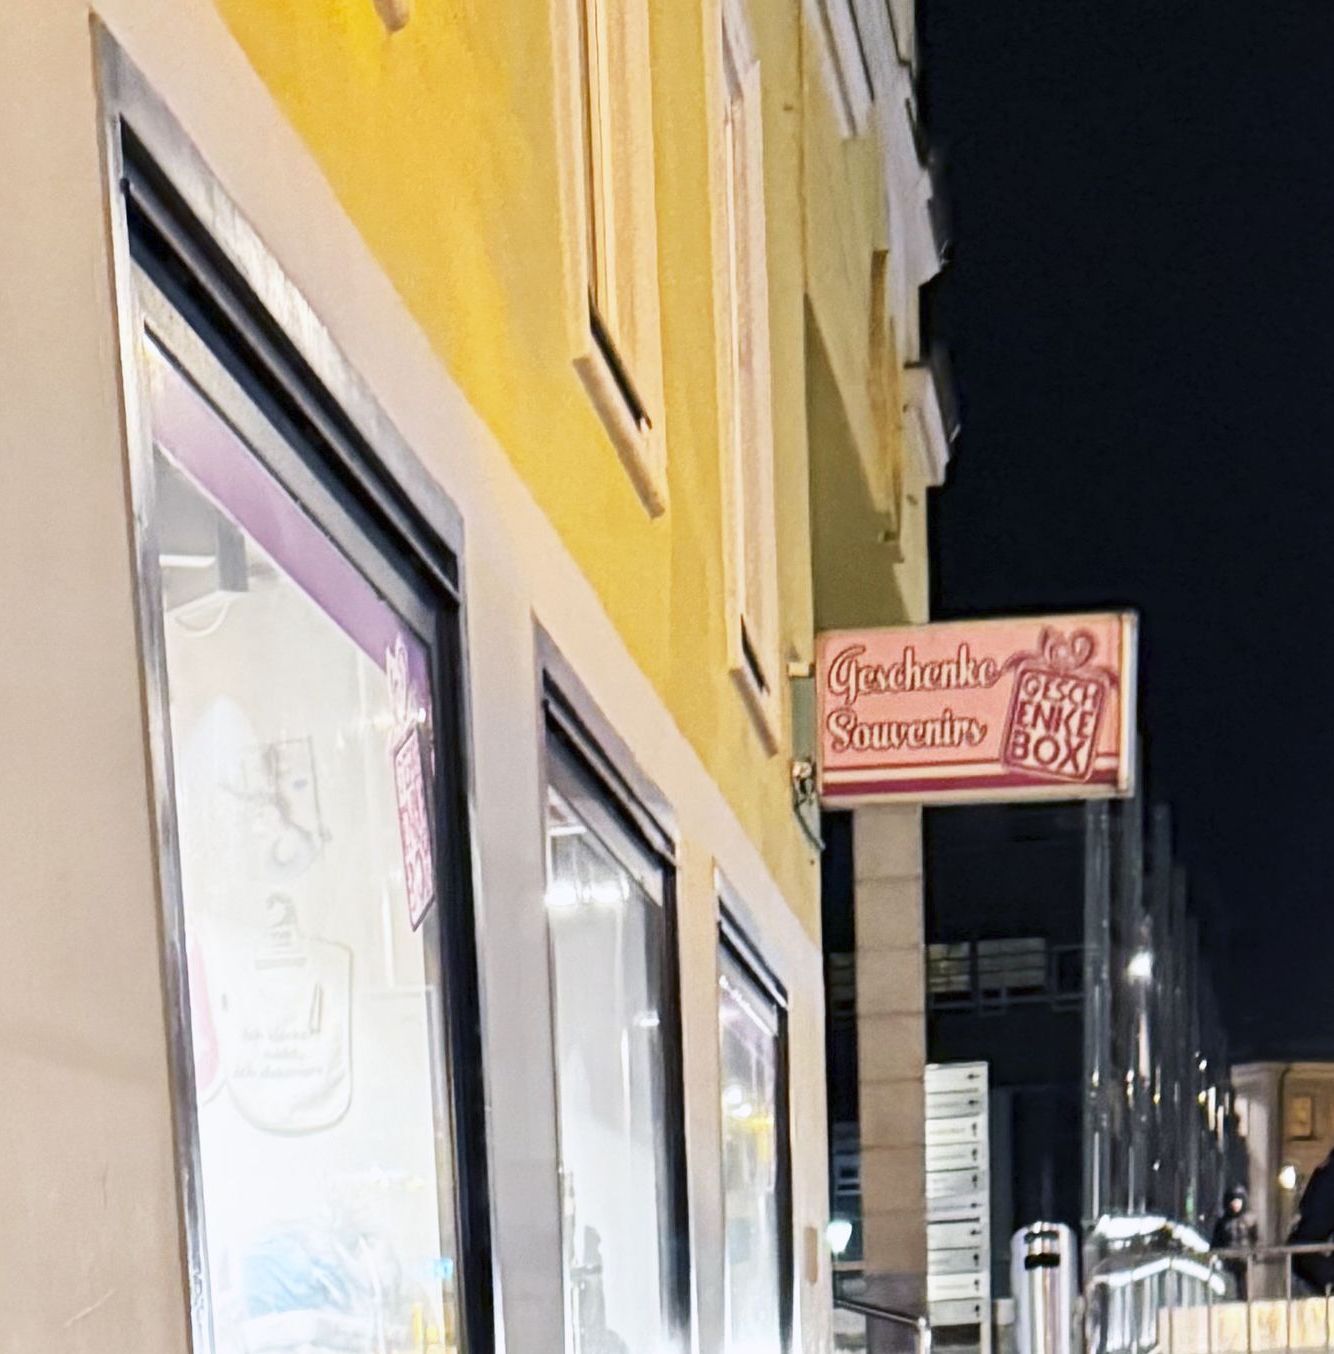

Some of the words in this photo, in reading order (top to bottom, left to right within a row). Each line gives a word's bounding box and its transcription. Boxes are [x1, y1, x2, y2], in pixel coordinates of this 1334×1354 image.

[827, 641, 1002, 706] Geschenke
[826, 706, 988, 753] Souvenirs
[1017, 700, 1094, 738] ENKE
[1012, 729, 1086, 773] BOX
